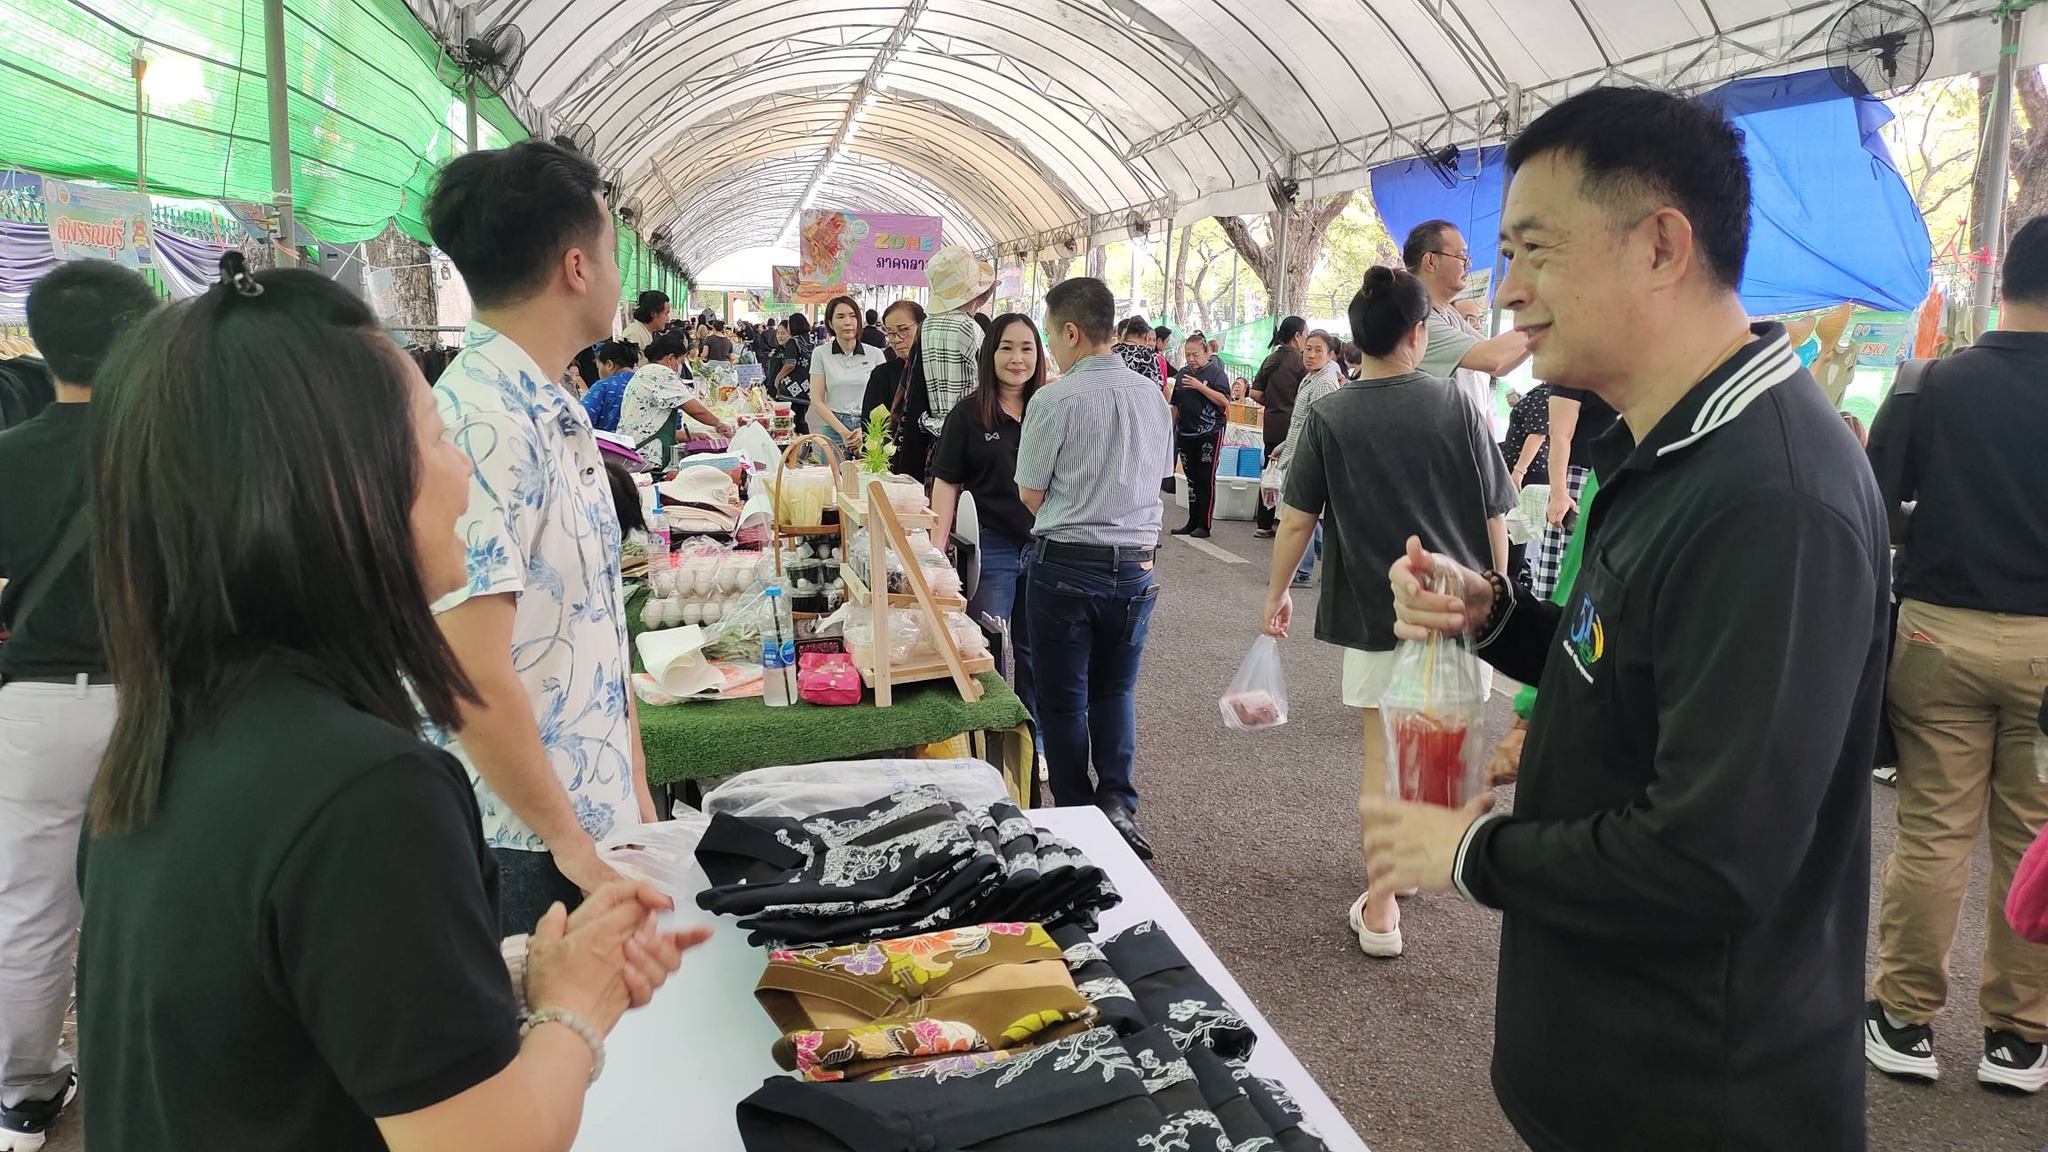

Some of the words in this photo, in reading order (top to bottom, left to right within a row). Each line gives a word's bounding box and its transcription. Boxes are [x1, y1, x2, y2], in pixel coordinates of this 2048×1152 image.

[57, 216, 126, 260] สุพรรณบุรี
[875, 233, 933, 252] ZONE
[876, 256, 929, 271] ภาคกลา
